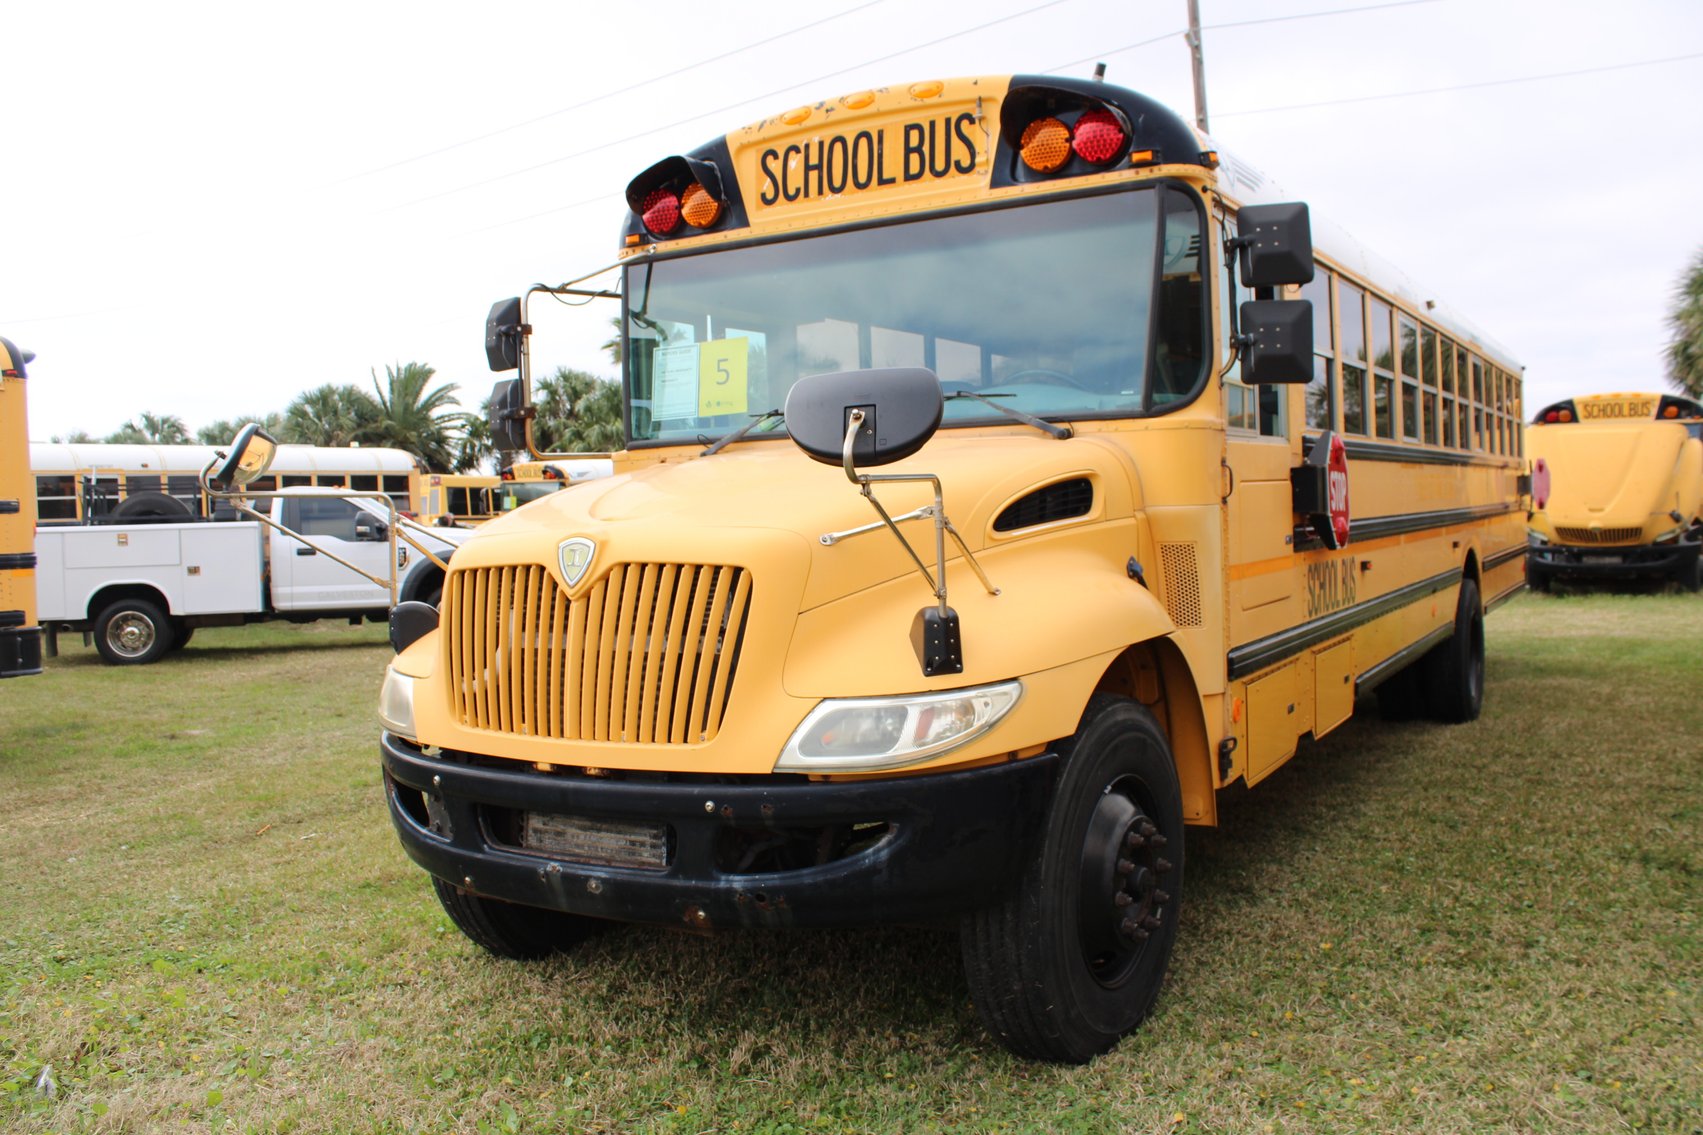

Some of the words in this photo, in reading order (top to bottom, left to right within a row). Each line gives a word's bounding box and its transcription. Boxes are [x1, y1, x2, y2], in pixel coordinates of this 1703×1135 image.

[759, 128, 897, 206] SCHOOL
[903, 112, 977, 183] BUS
[715, 358, 730, 385] 5
[1583, 402, 1626, 419] SCHOOL
[1628, 401, 1651, 417] BUS
[1329, 470, 1347, 512] STOP
[1307, 559, 1340, 619] SCHOOL
[1341, 556, 1357, 605] BUS
